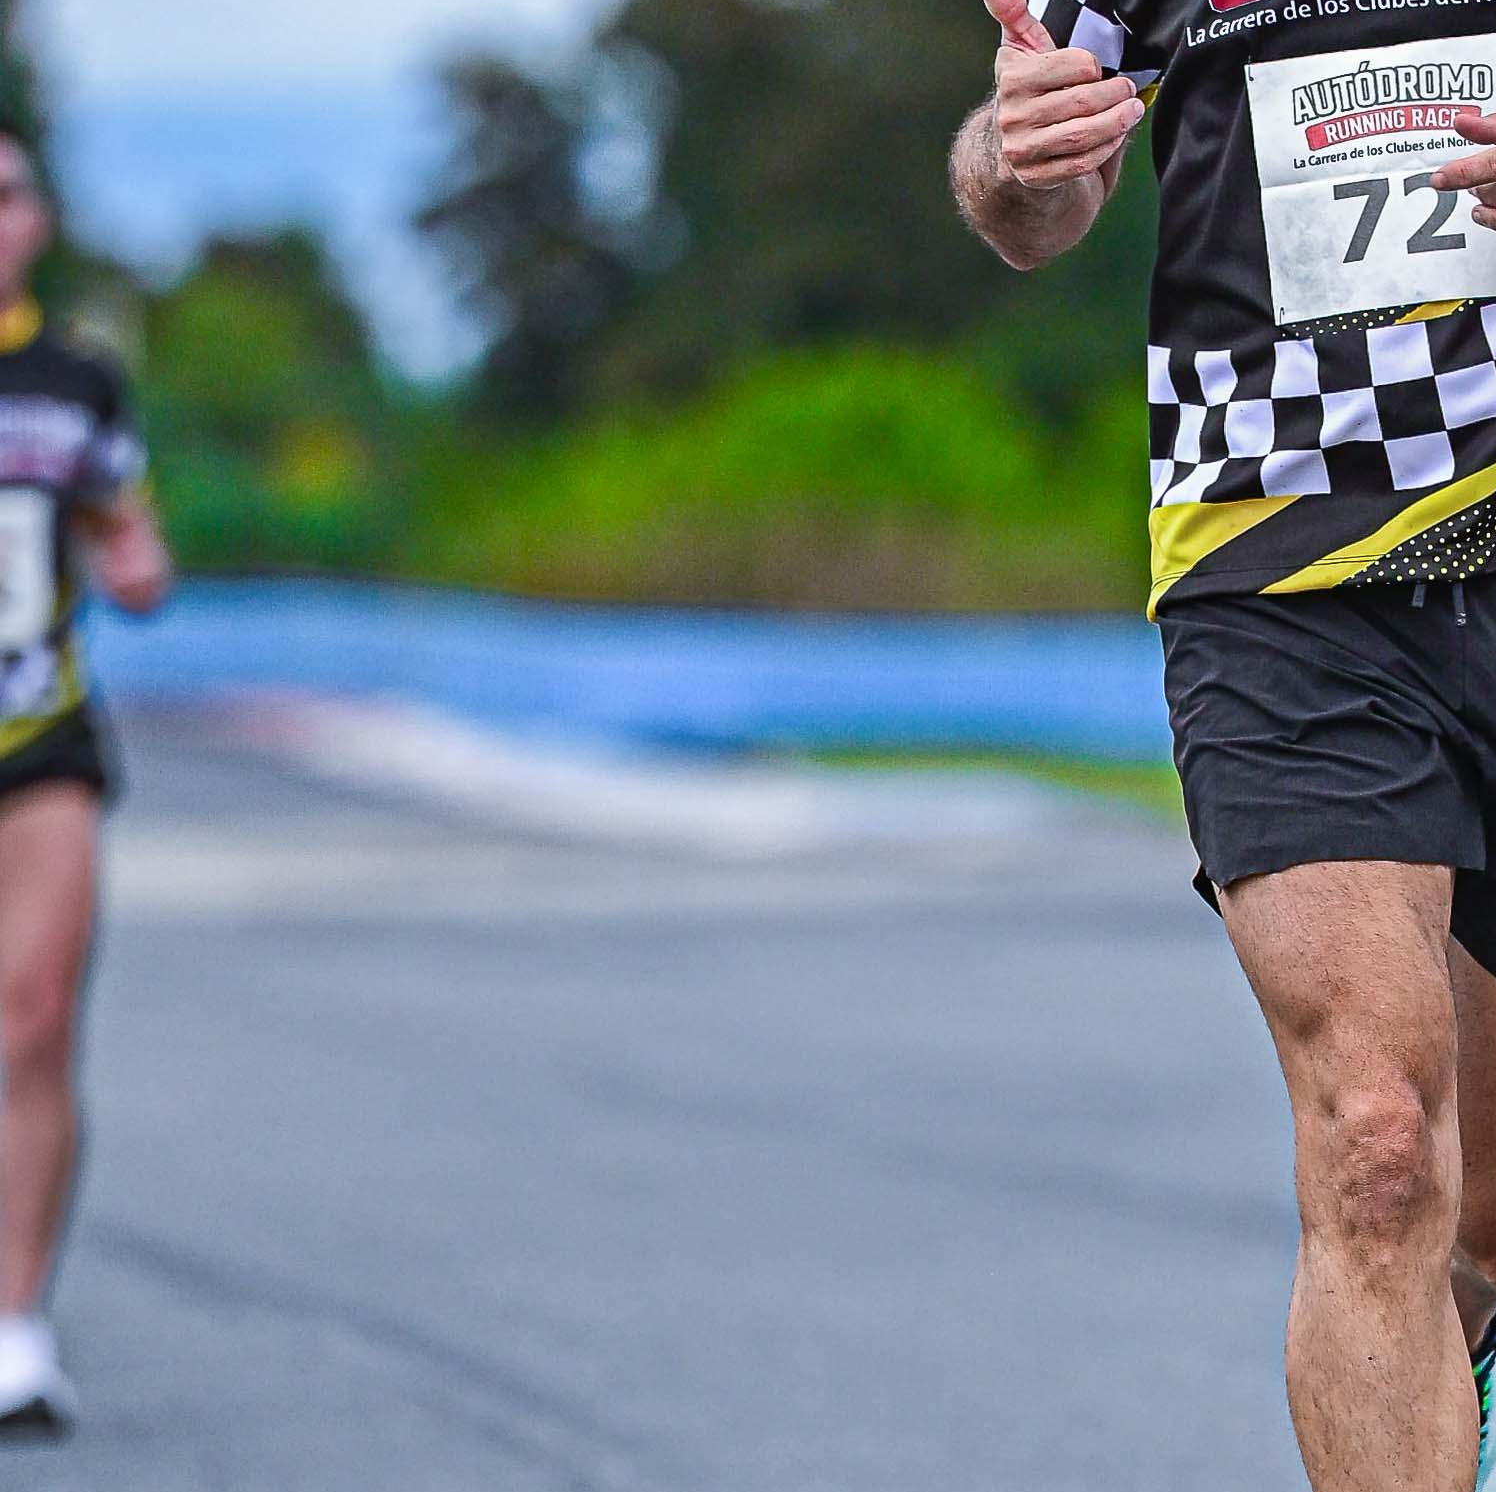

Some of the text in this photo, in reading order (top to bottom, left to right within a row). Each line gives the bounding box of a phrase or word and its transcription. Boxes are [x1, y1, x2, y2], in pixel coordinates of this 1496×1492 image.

[1186, 26, 1206, 48] La
[1208, 8, 1277, 39] Carrera
[1283, 0, 1312, 20] de
[1293, 60, 1494, 126] AUTÓDROMO
[1324, 108, 1406, 144] RUNNING
[1293, 158, 1307, 170] La
[1308, 149, 1348, 167] Carrera
[1350, 148, 1364, 160] de
[1367, 145, 1383, 157] los
[1385, 141, 1425, 155] Clubes
[1427, 138, 1445, 151] del
[1333, 172, 1467, 264] 72
